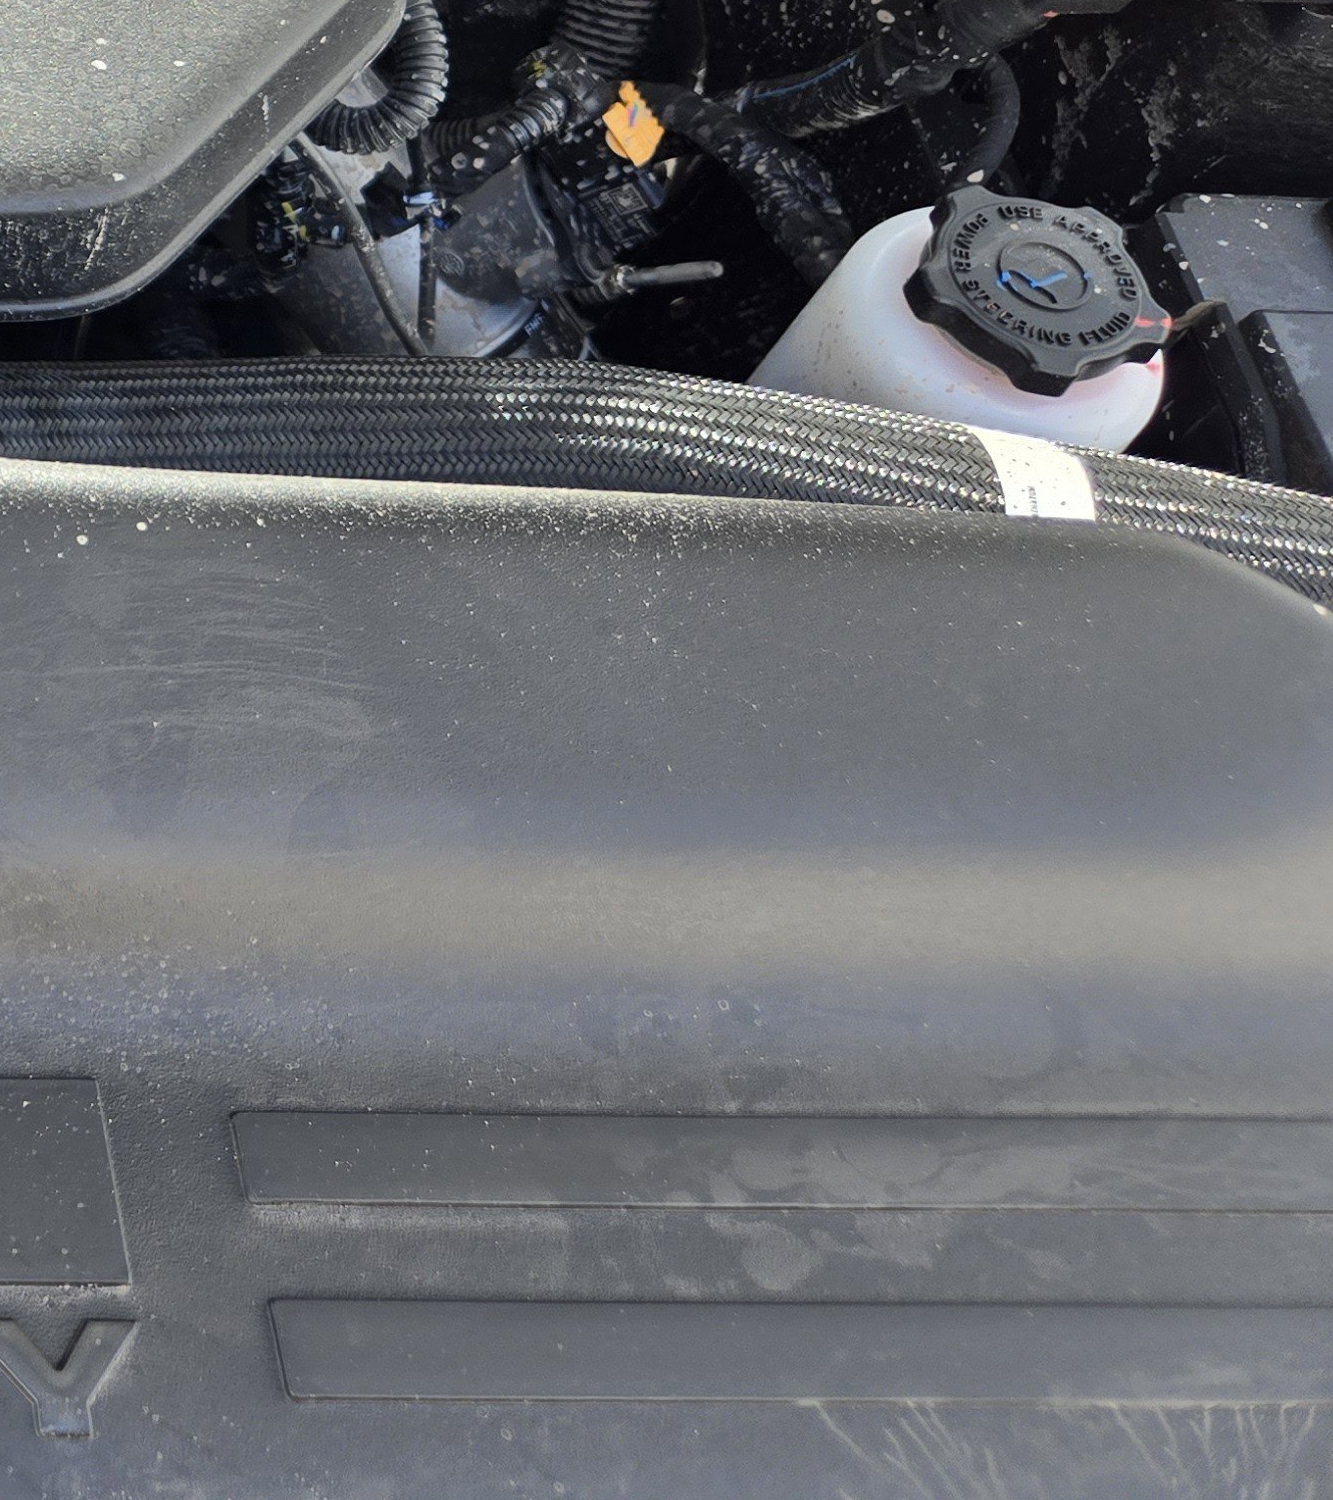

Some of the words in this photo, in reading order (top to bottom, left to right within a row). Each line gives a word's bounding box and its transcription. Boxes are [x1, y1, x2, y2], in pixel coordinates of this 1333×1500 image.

[952, 213, 989, 273] POWER
[997, 205, 1044, 222] USE
[1052, 215, 1138, 301] APPROVED
[962, 278, 1072, 347] STEERING
[1077, 310, 1131, 346] FLUID
